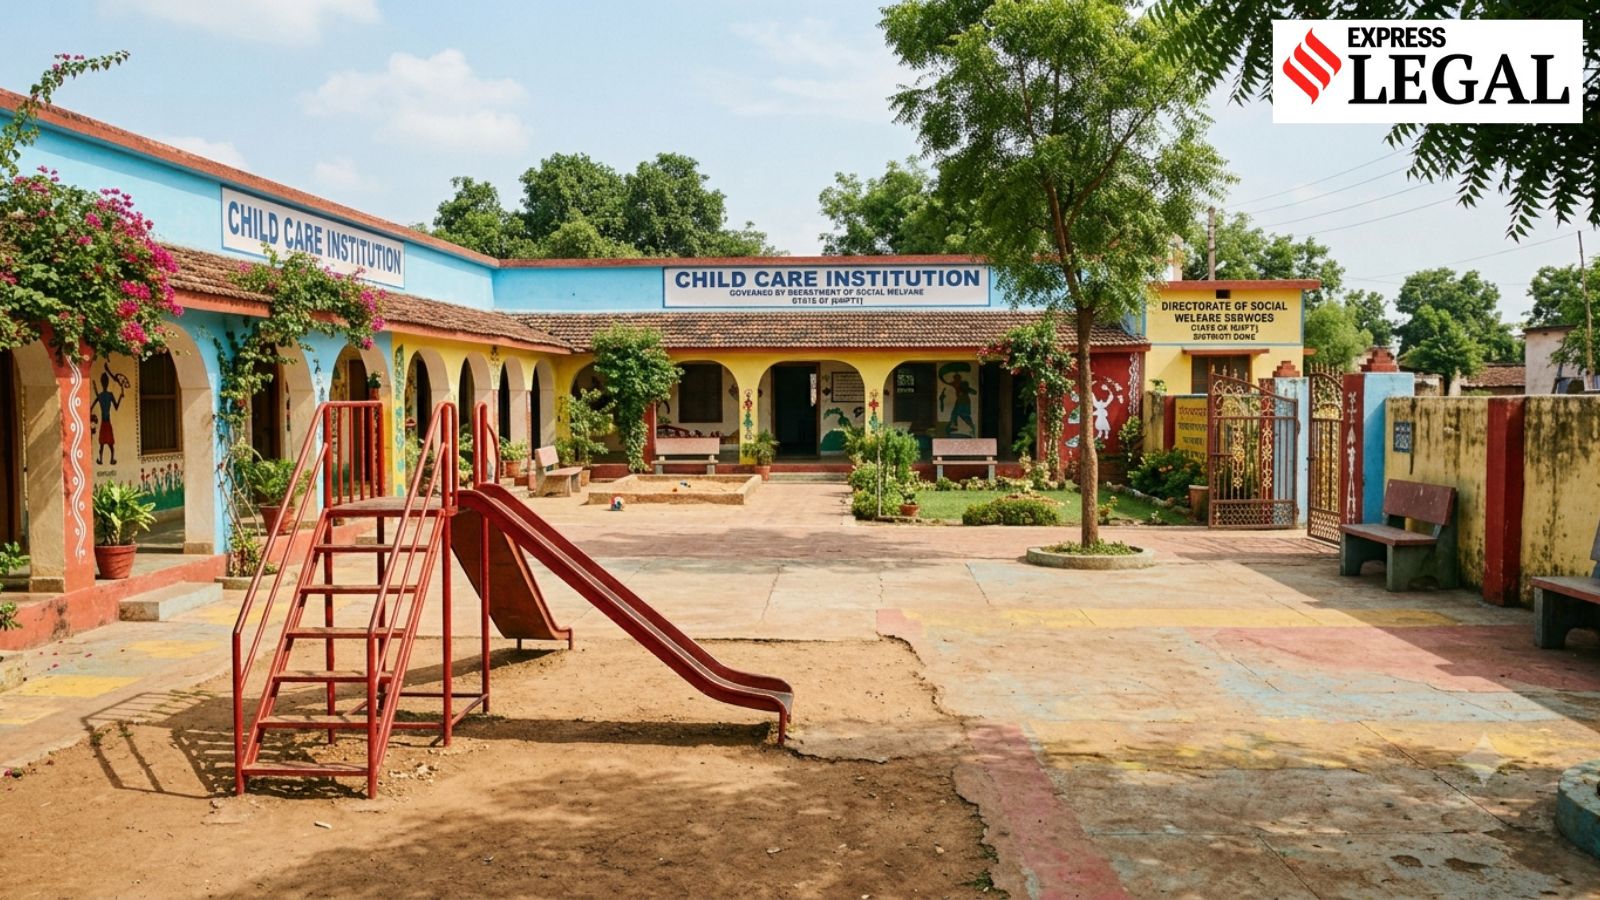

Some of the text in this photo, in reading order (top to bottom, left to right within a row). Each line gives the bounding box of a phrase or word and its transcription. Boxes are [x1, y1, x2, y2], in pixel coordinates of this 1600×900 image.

[228, 201, 401, 275] CHILD CARE INSTITUTION
[675, 270, 980, 288] CHILD CARE INSTITUTION
[1162, 301, 1231, 311] DIRECTORATE
[1251, 301, 1288, 311] SOCIAL
